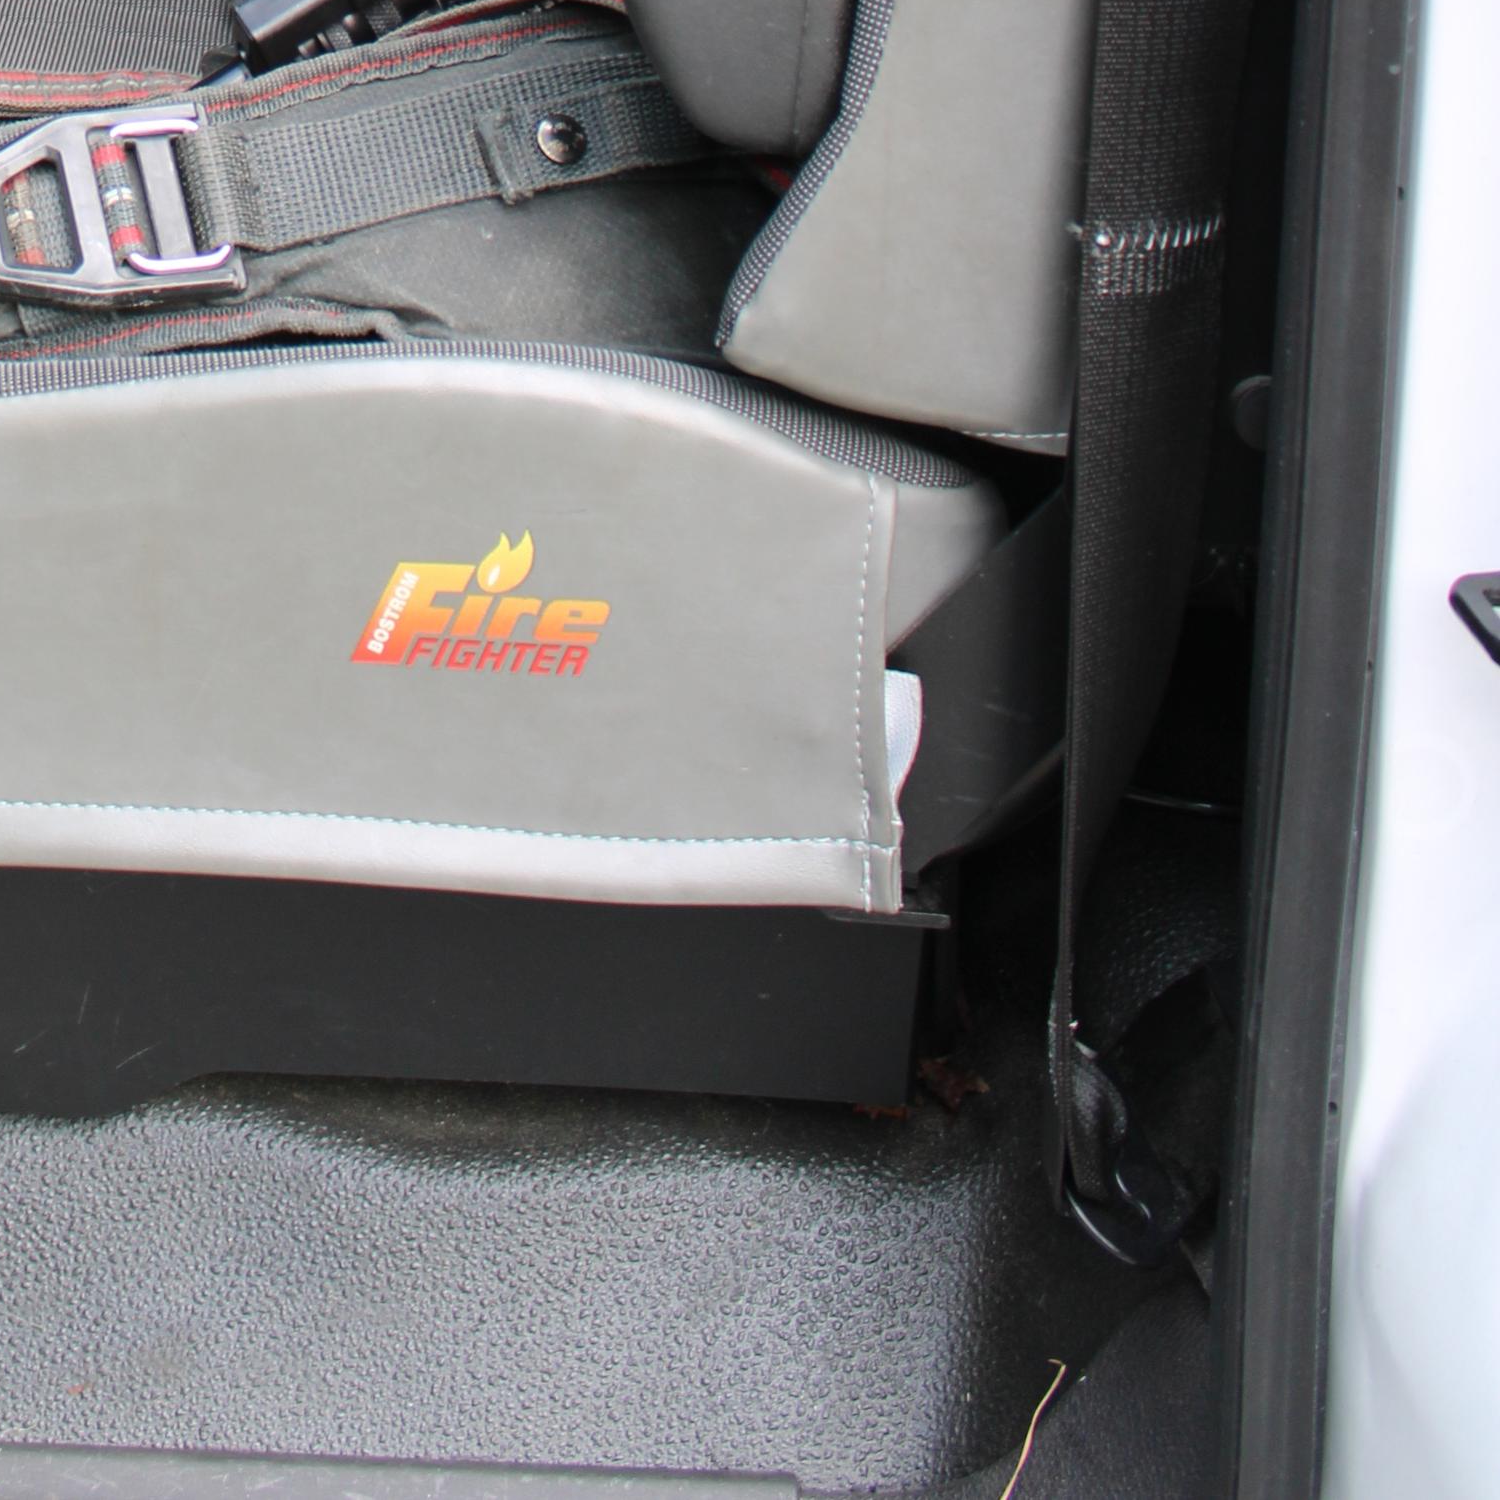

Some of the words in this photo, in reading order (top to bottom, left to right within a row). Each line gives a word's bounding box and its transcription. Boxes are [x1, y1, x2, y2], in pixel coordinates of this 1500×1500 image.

[350, 529, 611, 665] Fire
[367, 571, 420, 655] BOSTROM
[404, 637, 591, 678] FIGHTER
